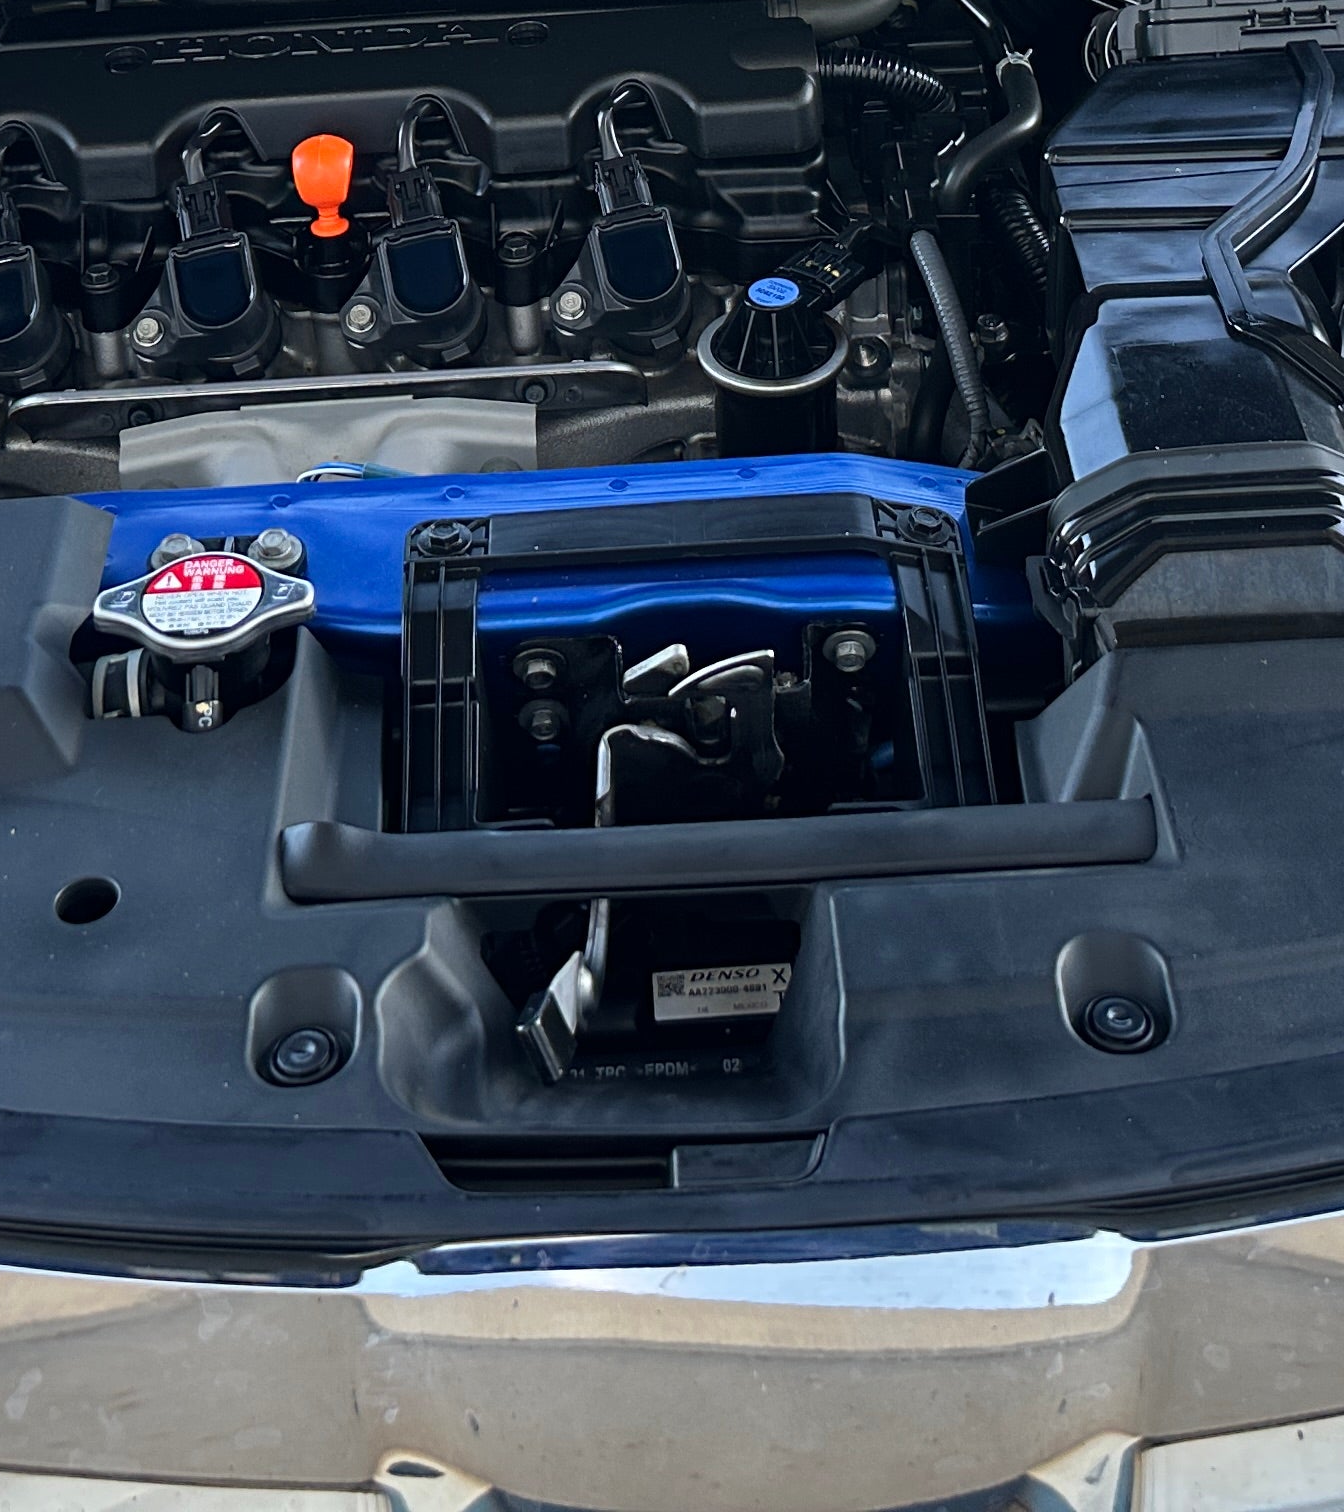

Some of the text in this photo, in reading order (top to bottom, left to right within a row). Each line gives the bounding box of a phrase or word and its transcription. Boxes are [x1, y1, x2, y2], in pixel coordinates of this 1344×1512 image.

[152, 24, 499, 64] HONDA
[183, 558, 235, 570] DANGER
[690, 967, 787, 984] DENSO X
